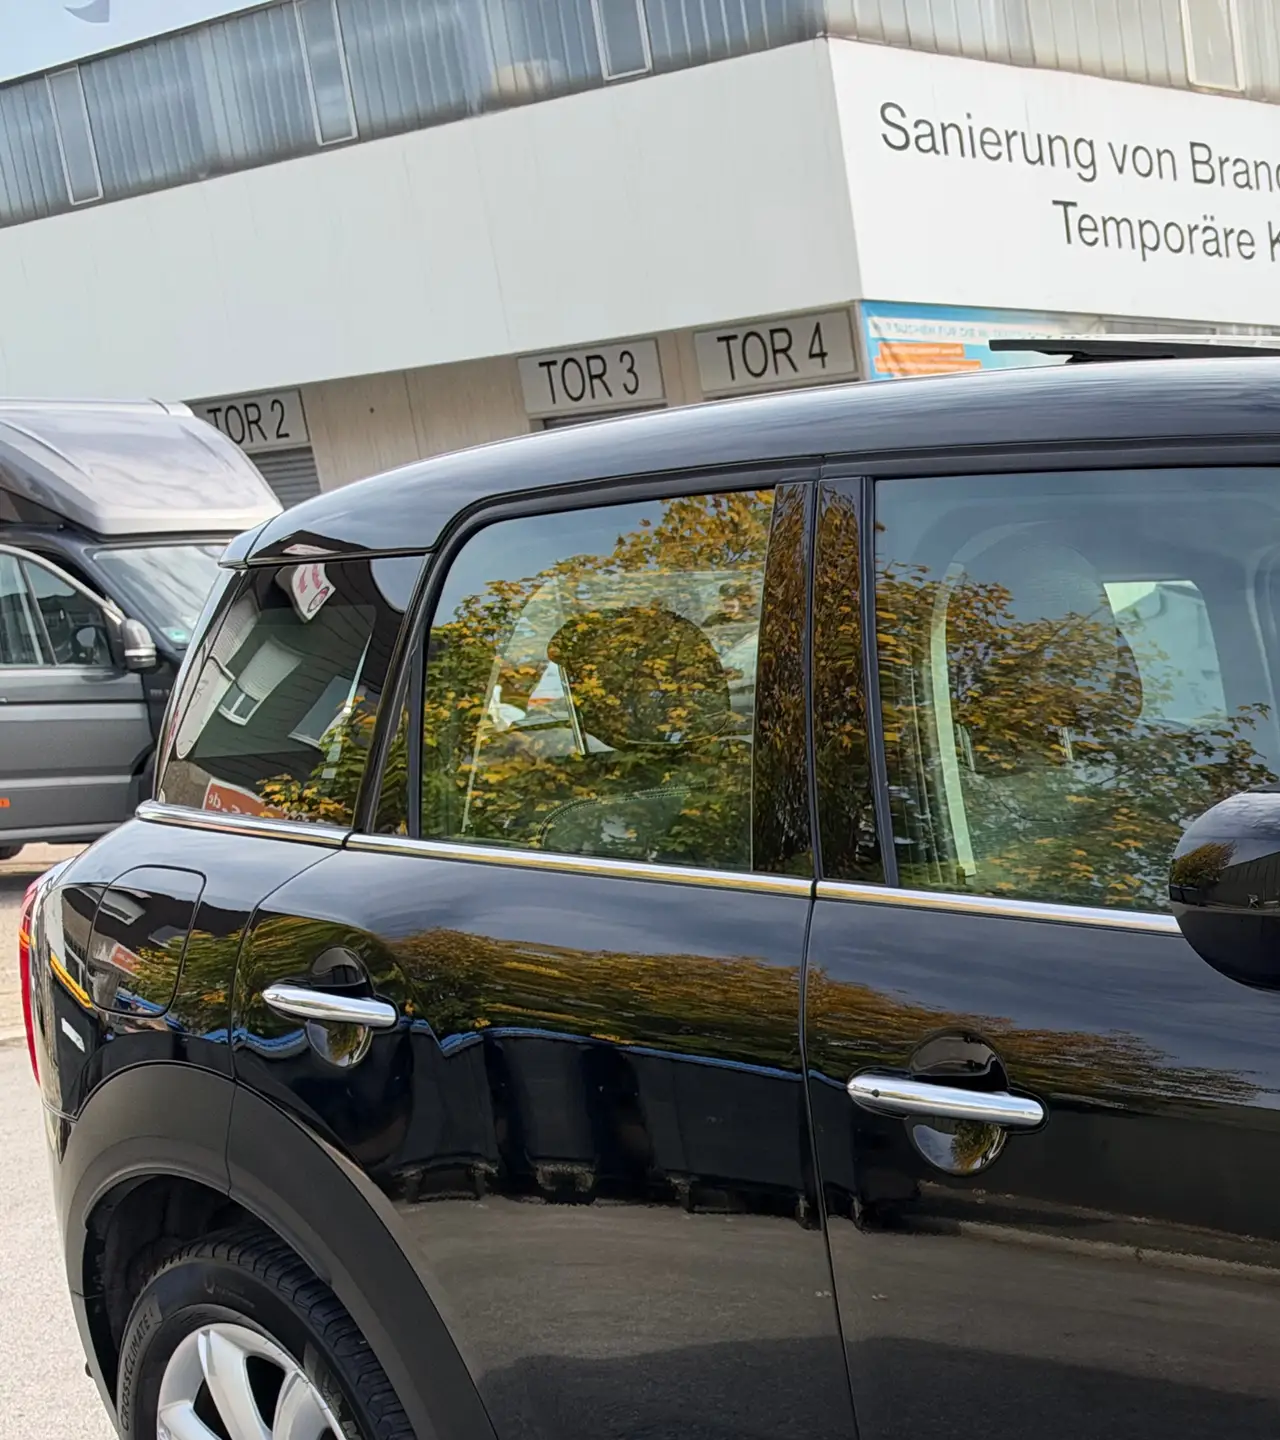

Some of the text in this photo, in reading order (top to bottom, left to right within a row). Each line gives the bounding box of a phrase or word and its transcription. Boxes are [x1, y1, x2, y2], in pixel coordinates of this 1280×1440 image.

[880, 102, 1097, 183] Sanierung
[1108, 142, 1178, 182] von
[1053, 199, 1256, 262] Temporäre
[537, 349, 640, 405] TOR 3
[716, 327, 799, 382] TOR
[808, 321, 829, 369] 4
[207, 398, 291, 446] TOR 2
